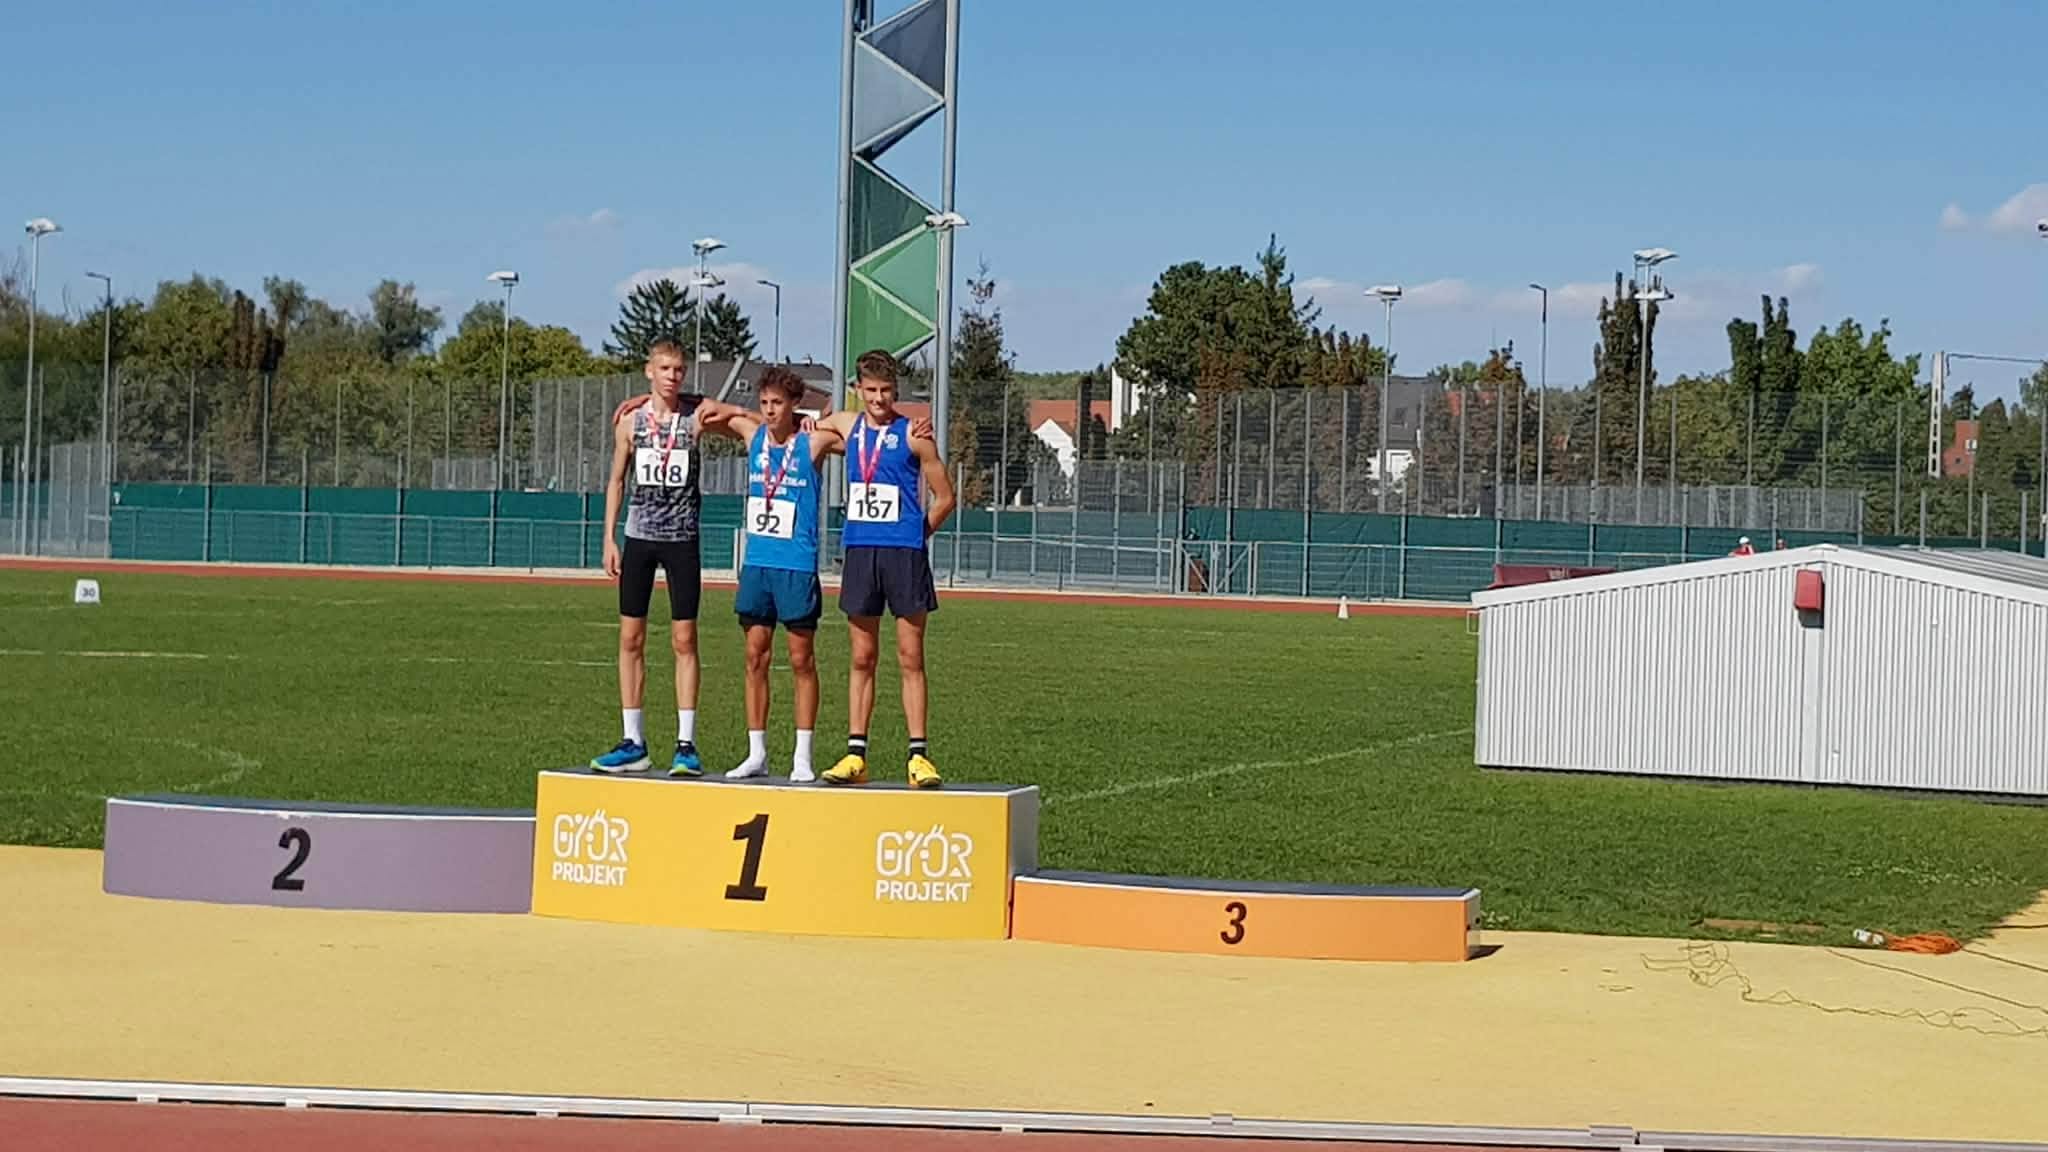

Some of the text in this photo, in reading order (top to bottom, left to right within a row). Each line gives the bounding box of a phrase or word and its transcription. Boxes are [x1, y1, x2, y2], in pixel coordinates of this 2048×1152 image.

[642, 464, 682, 483] 108
[855, 499, 893, 519] 167
[756, 513, 780, 534] 92
[82, 587, 96, 598] 30
[272, 827, 311, 891] 2
[724, 813, 770, 901] 1
[552, 861, 628, 887] PROJEKT
[875, 879, 972, 903] PROJEKT
[1220, 901, 1247, 944] 3
